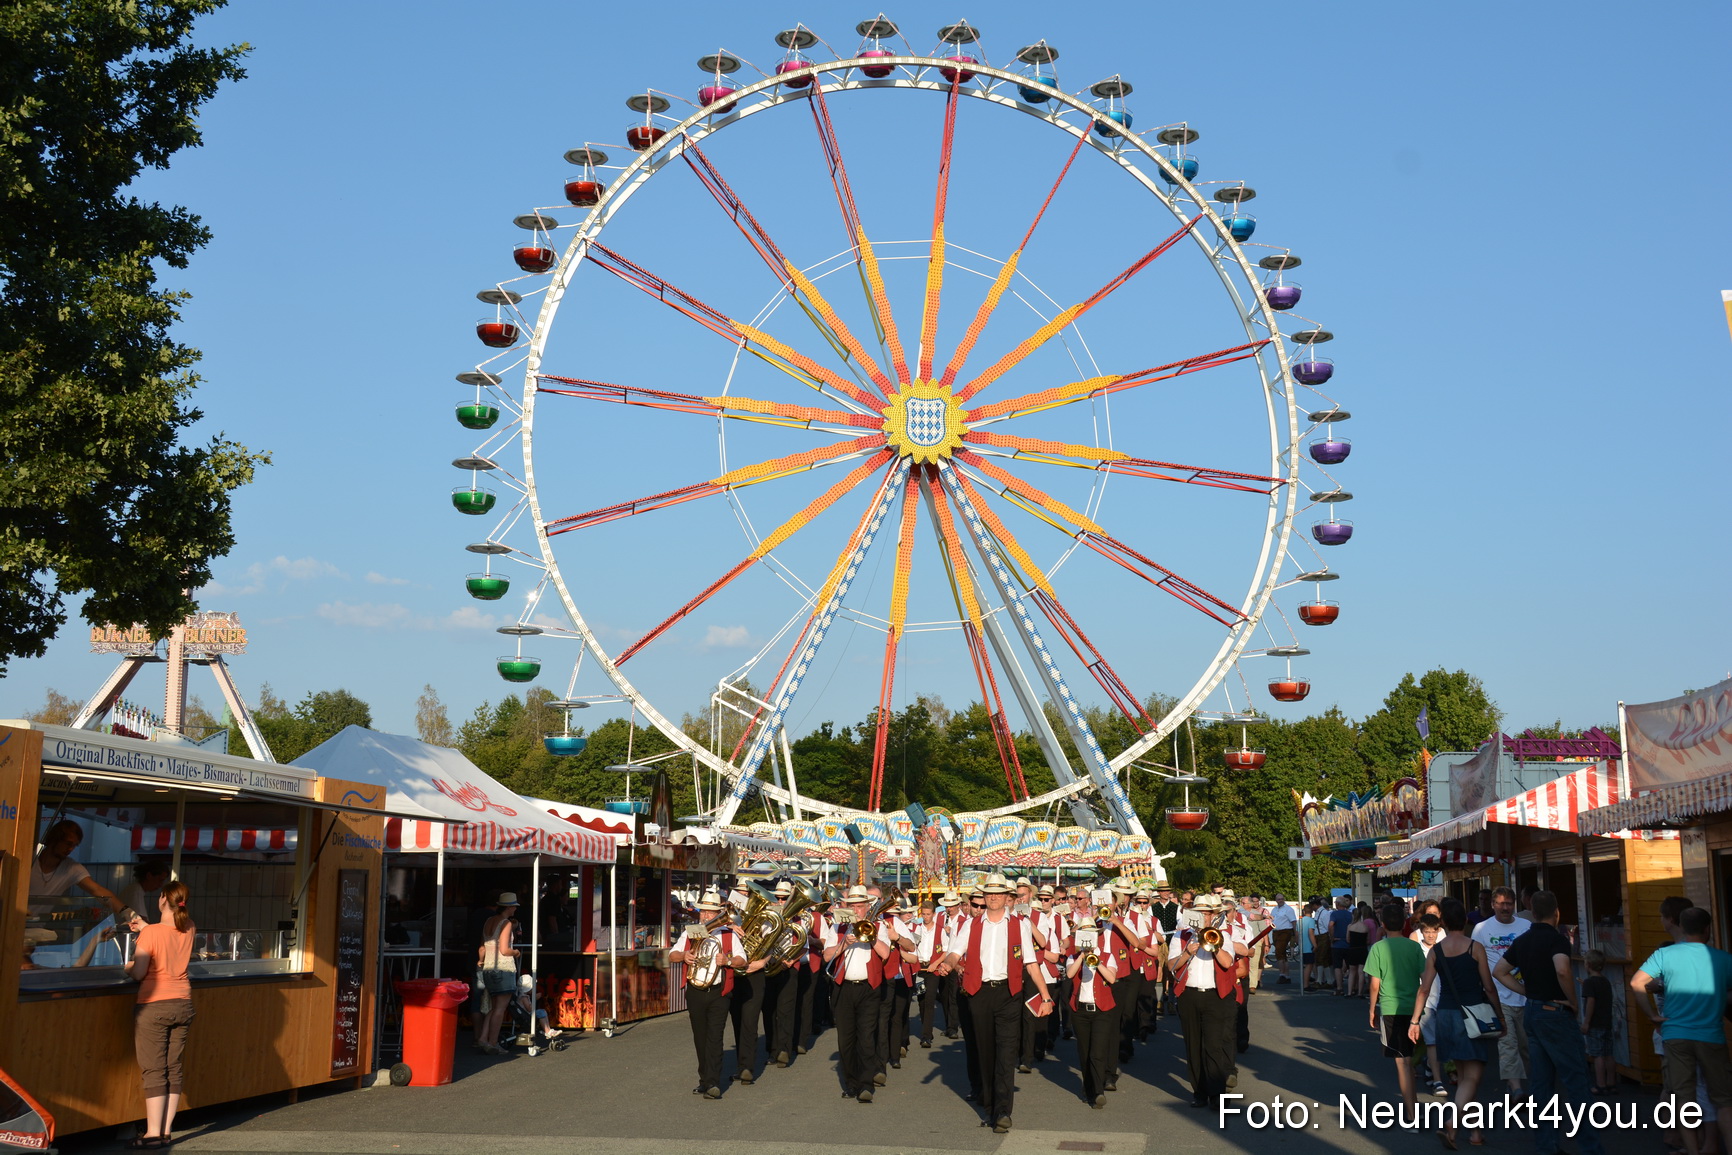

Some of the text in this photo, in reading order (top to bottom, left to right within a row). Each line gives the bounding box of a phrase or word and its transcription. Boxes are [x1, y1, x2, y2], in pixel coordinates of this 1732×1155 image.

[184, 628, 248, 643] BURNER
[56, 740, 301, 793] Original Backfisch Matjes- Bismarck- Lachssemmel
[332, 831, 382, 849] Die Fischküche
